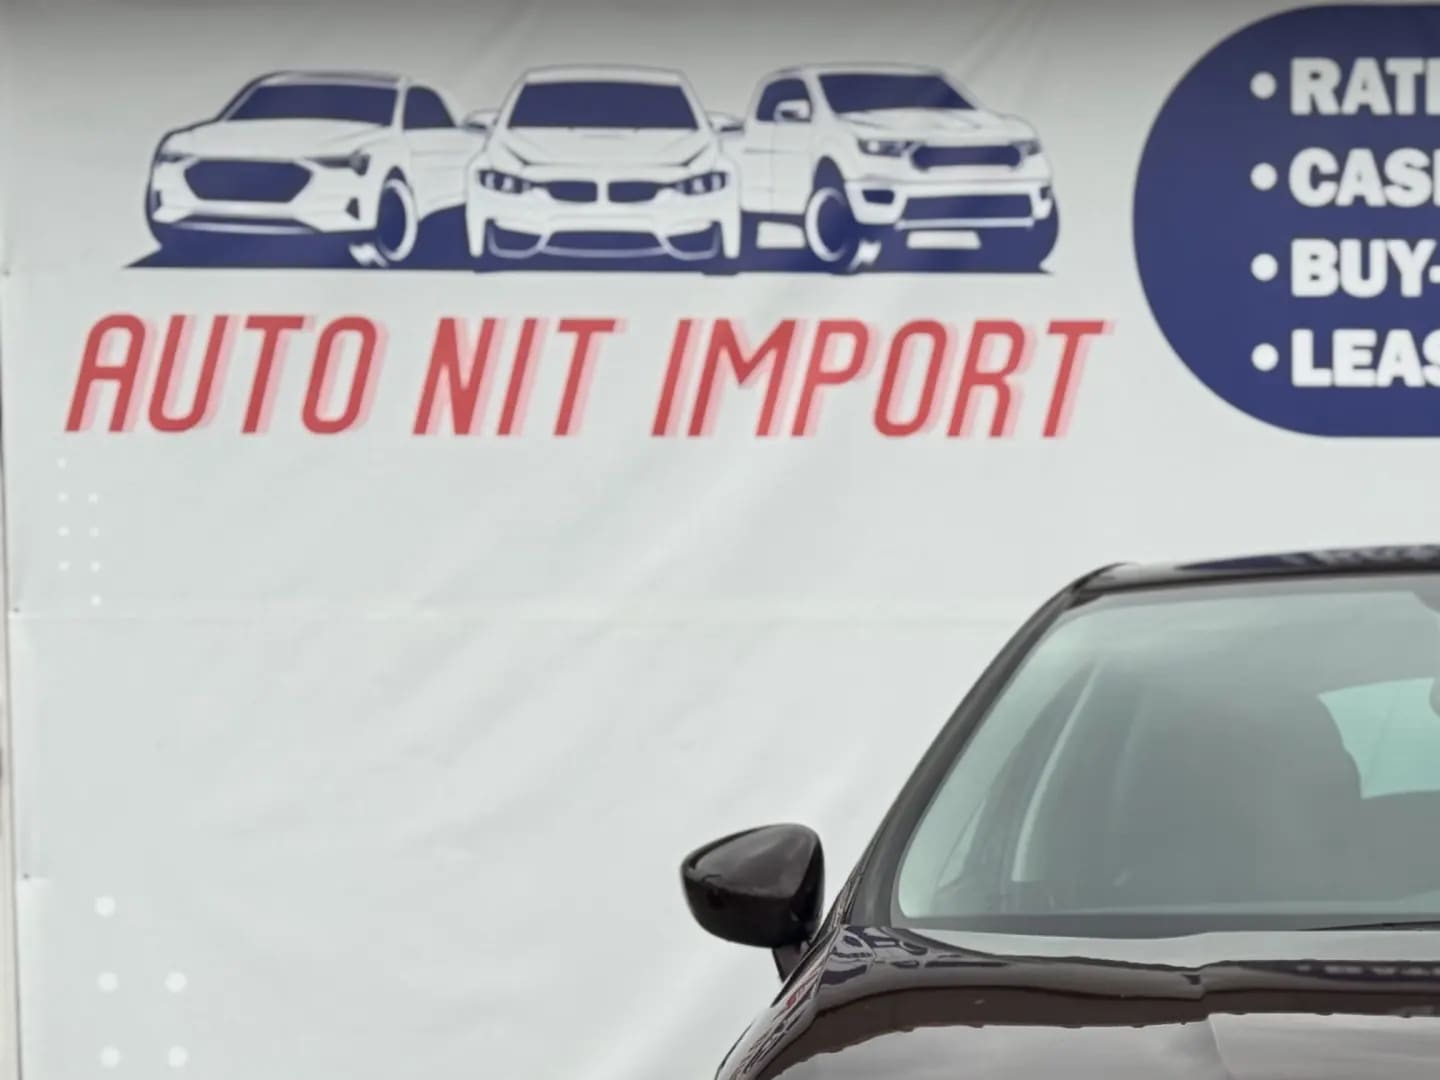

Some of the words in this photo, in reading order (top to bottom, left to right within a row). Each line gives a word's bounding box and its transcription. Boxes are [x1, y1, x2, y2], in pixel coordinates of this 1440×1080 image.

[65, 313, 388, 435] AUTO
[412, 316, 628, 438] NIT
[650, 318, 1116, 440] IMPORT
